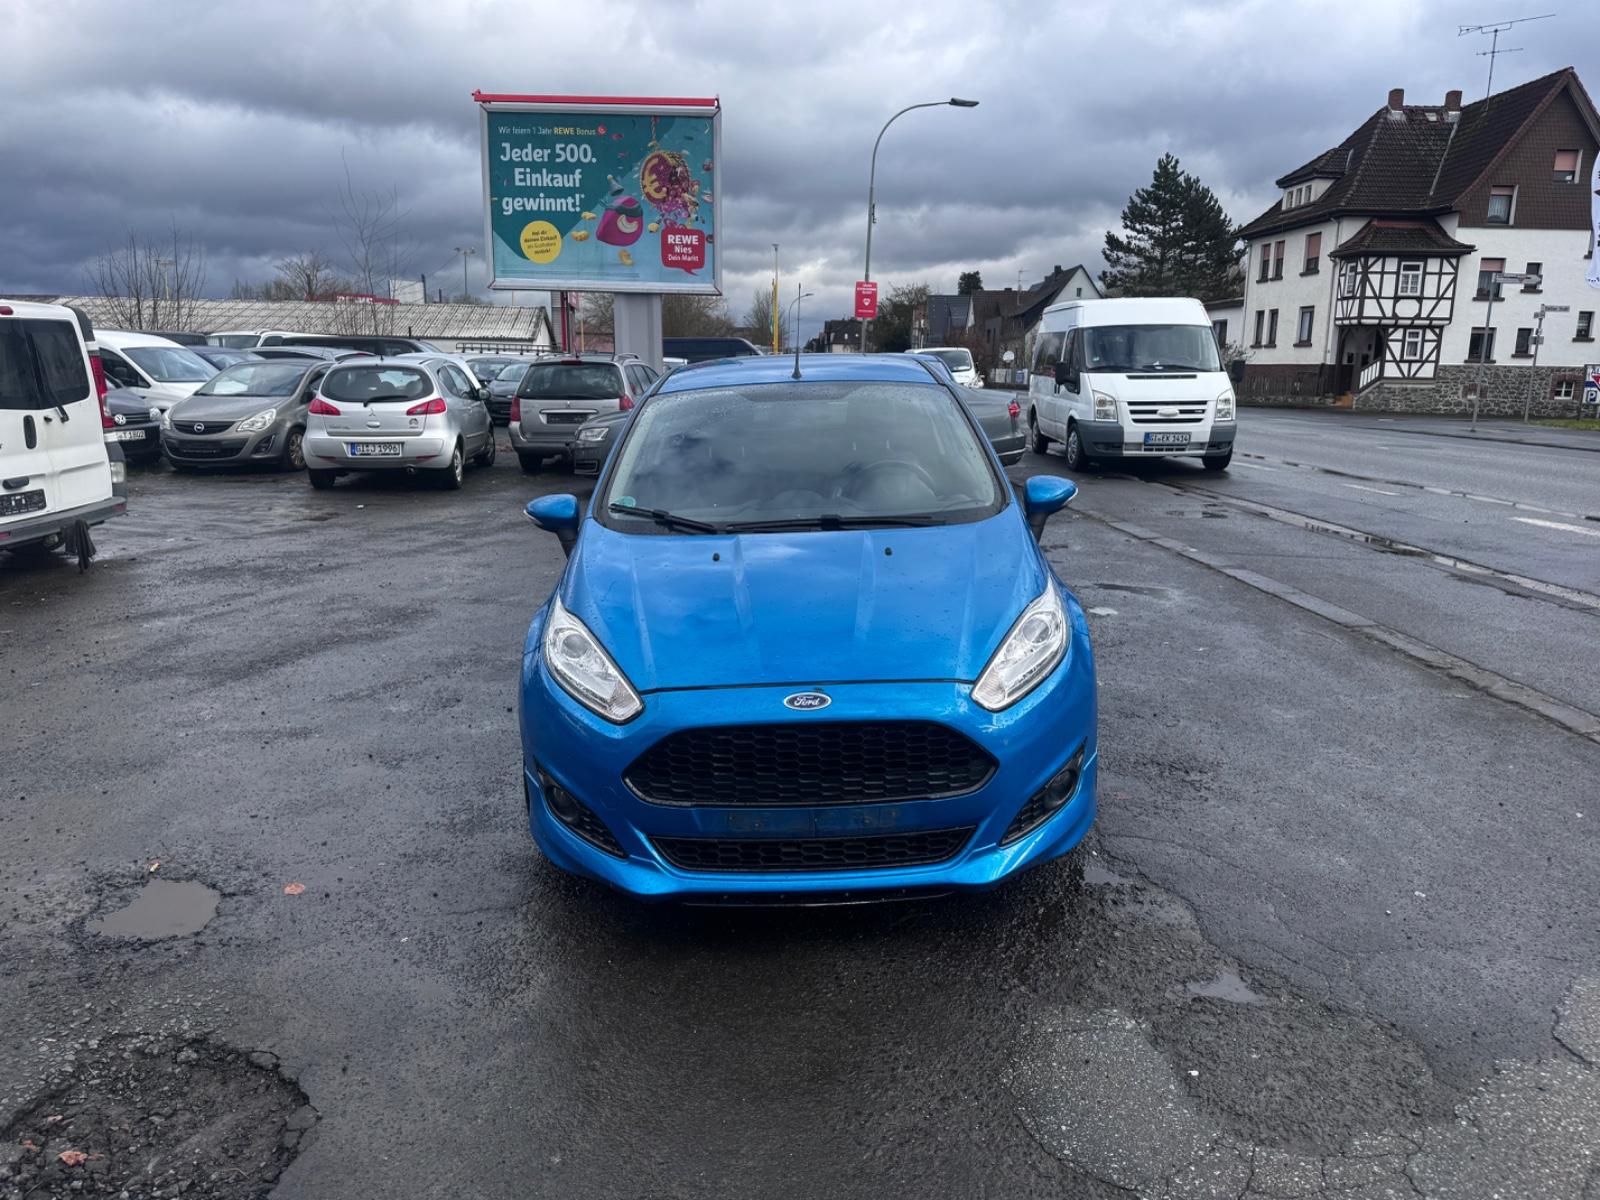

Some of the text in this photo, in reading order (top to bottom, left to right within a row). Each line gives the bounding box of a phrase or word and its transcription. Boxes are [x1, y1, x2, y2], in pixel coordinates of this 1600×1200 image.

[499, 126, 510, 134] Wir
[512, 126, 531, 134] feiern
[537, 127, 552, 135] Jahr
[553, 127, 574, 135] REWE
[500, 142, 597, 163] Jeder 500.
[514, 167, 582, 187] Einkauf
[667, 234, 699, 245] REWE
[674, 245, 693, 254] Nies
[378, 443, 398, 453] 1996
[794, 695, 820, 707] Ford
